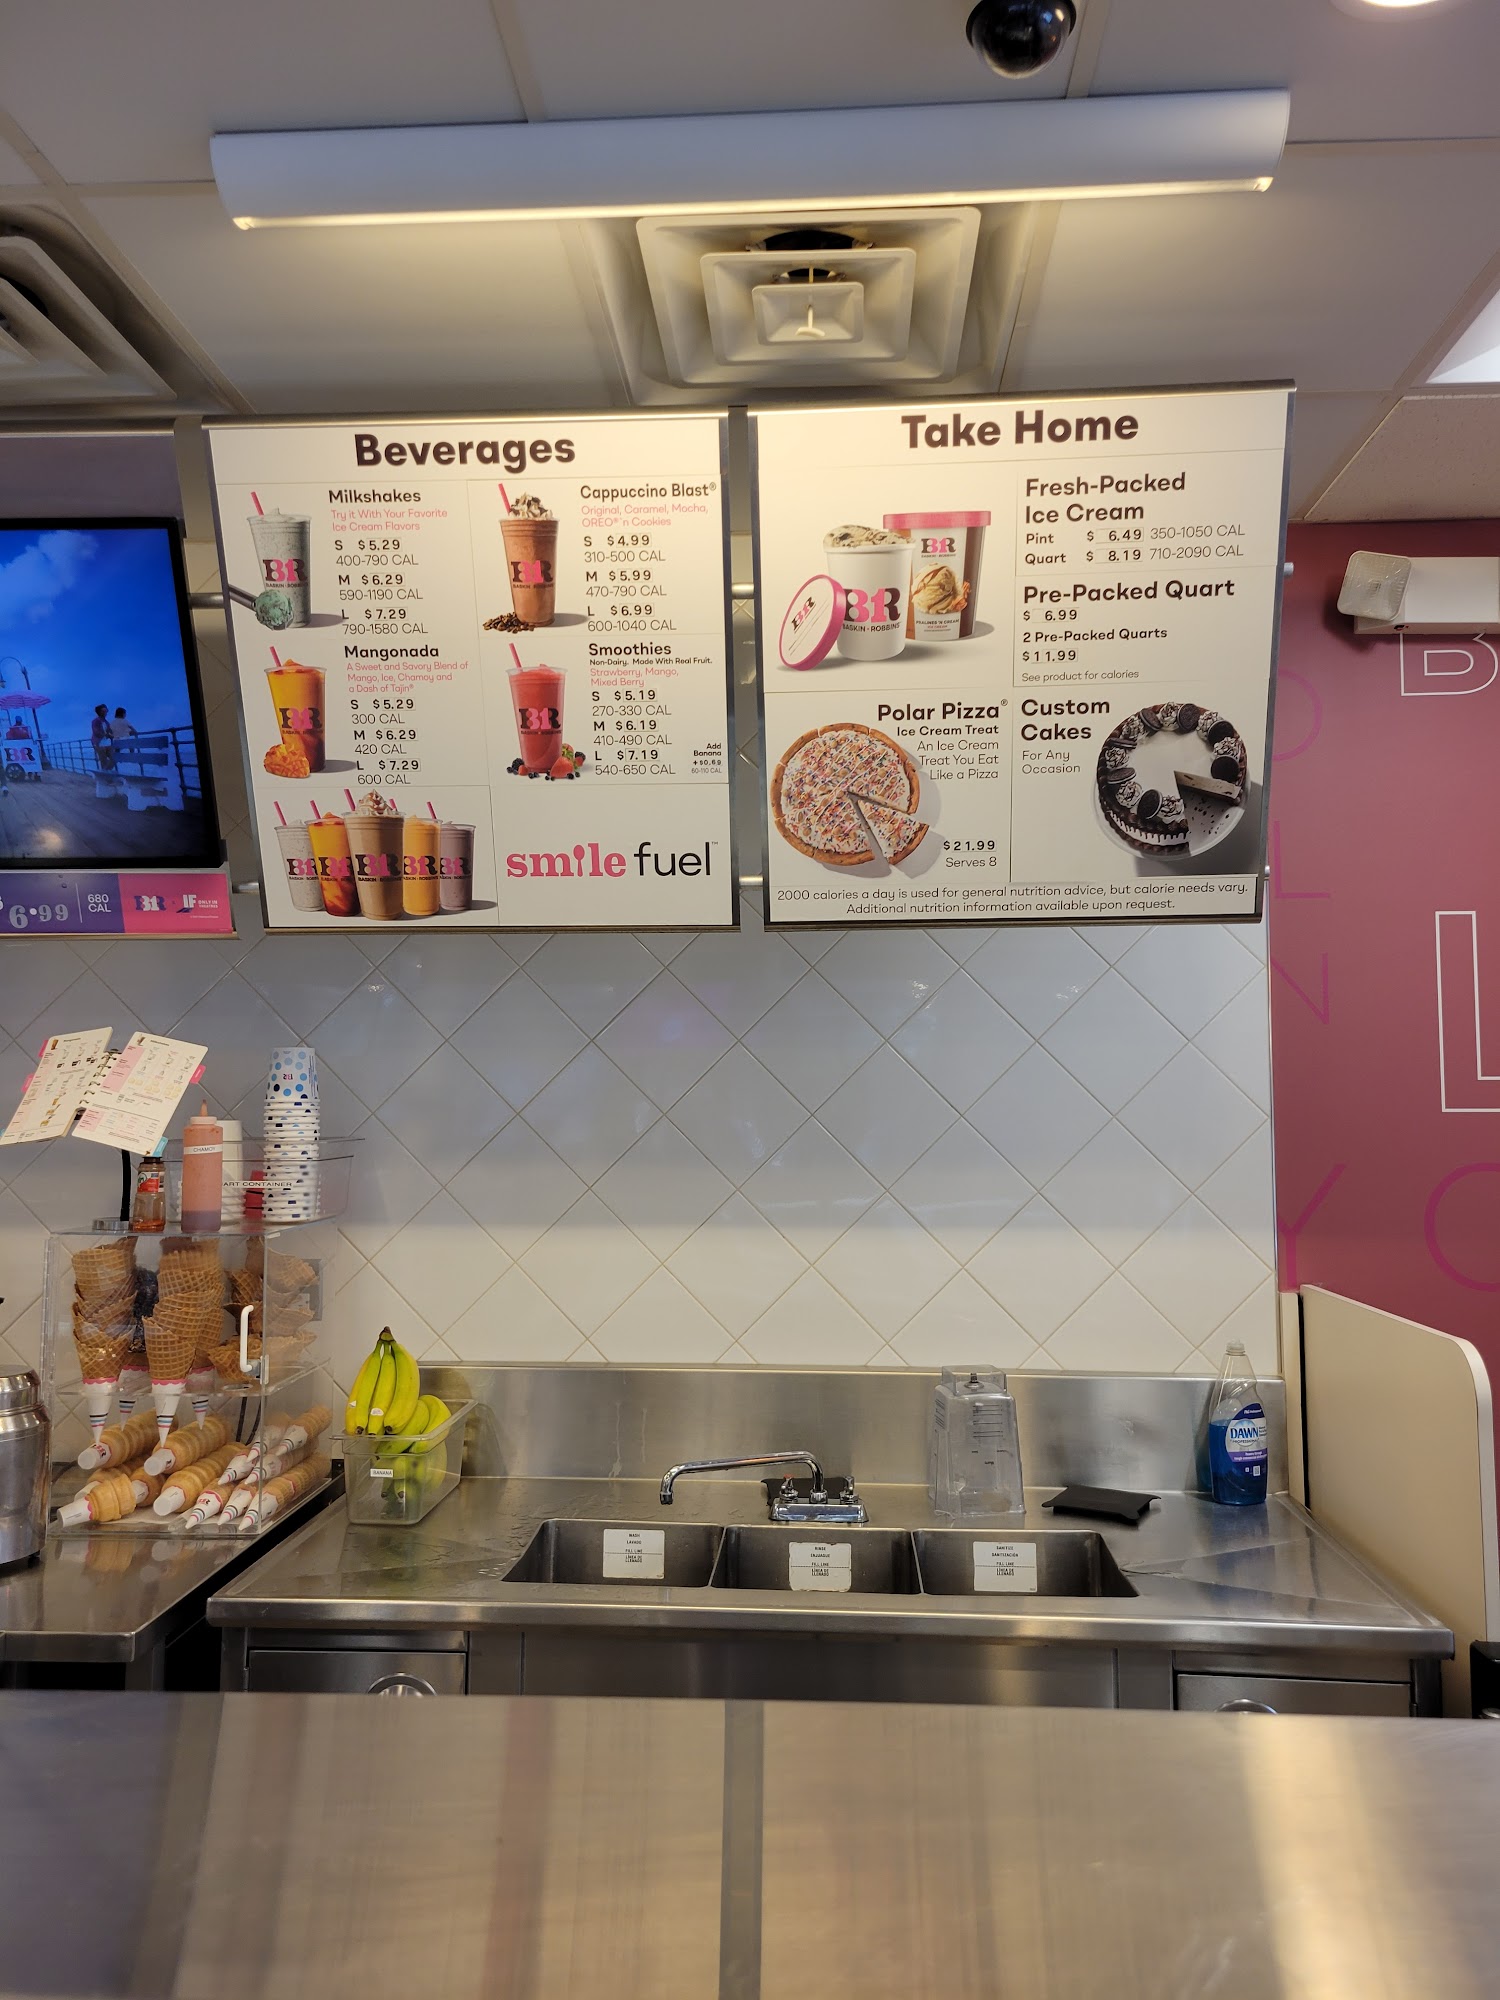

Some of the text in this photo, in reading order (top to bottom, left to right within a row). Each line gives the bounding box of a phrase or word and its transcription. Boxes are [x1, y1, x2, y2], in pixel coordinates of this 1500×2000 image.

[901, 409, 1139, 449] Take Home
[354, 433, 576, 474] Beverages
[1025, 471, 1186, 497] Fresh-Packed
[328, 489, 422, 504] Milkshakes
[580, 484, 667, 502] Cappuccino
[331, 508, 448, 521] Try it With Your Favorite
[581, 502, 709, 516] Original, Caramel, Mocha,
[1025, 503, 1144, 524] Ice Cream
[332, 521, 420, 532] Ice Cream Flavors
[1026, 532, 1054, 544] Pint
[1150, 525, 1213, 540] 350-1050
[1216, 523, 1246, 537] CAL
[334, 539, 343, 550] S
[583, 536, 592, 547] S
[336, 554, 419, 566] 400-790 CAL
[584, 550, 666, 563] 310-500 CAL
[1024, 552, 1067, 566] Quart
[1150, 546, 1211, 560] 710-2090
[1215, 544, 1244, 558] CAL
[1024, 579, 1235, 604] Pre-Packed Quart
[1022, 627, 1168, 643] 2 Pre-Packed Quarts
[344, 645, 439, 661] Mangonada
[588, 642, 672, 656] Smoothies
[346, 660, 469, 673] A Sweet and Savory Blend of
[589, 656, 713, 667] Non-Dairy. Made With Real Fruit.
[347, 672, 452, 684] Mango, Ice, Chamoy and
[590, 666, 679, 678] Strawberry, Mango,
[1021, 669, 1140, 684] See product for calories
[590, 677, 645, 688] Mixed Berry
[592, 691, 600, 701] S
[592, 704, 672, 717] 270-330 CAL
[878, 704, 935, 721] Polar
[1021, 698, 1111, 716] Custom
[354, 730, 365, 740] M
[897, 725, 999, 736] Ice Cream Treat
[1020, 723, 1092, 741] Cakes
[355, 743, 407, 755] 420 CAL
[917, 740, 999, 751] An Ice Cream
[919, 754, 999, 766] Treat You Eat
[1022, 750, 1070, 762] For Any
[929, 769, 999, 780] Like a Pizza
[1021, 763, 1081, 774] Occasion
[945, 856, 997, 868] Serves 8
[87, 894, 109, 903] 680
[777, 882, 1249, 902] 2000 calories a day is used for general nutrition advice, but calorie needs vary.
[88, 903, 112, 913] CAL
[846, 899, 1176, 914] Additional nutrition information available upon request.
[1230, 1427, 1259, 1438] DAWN
